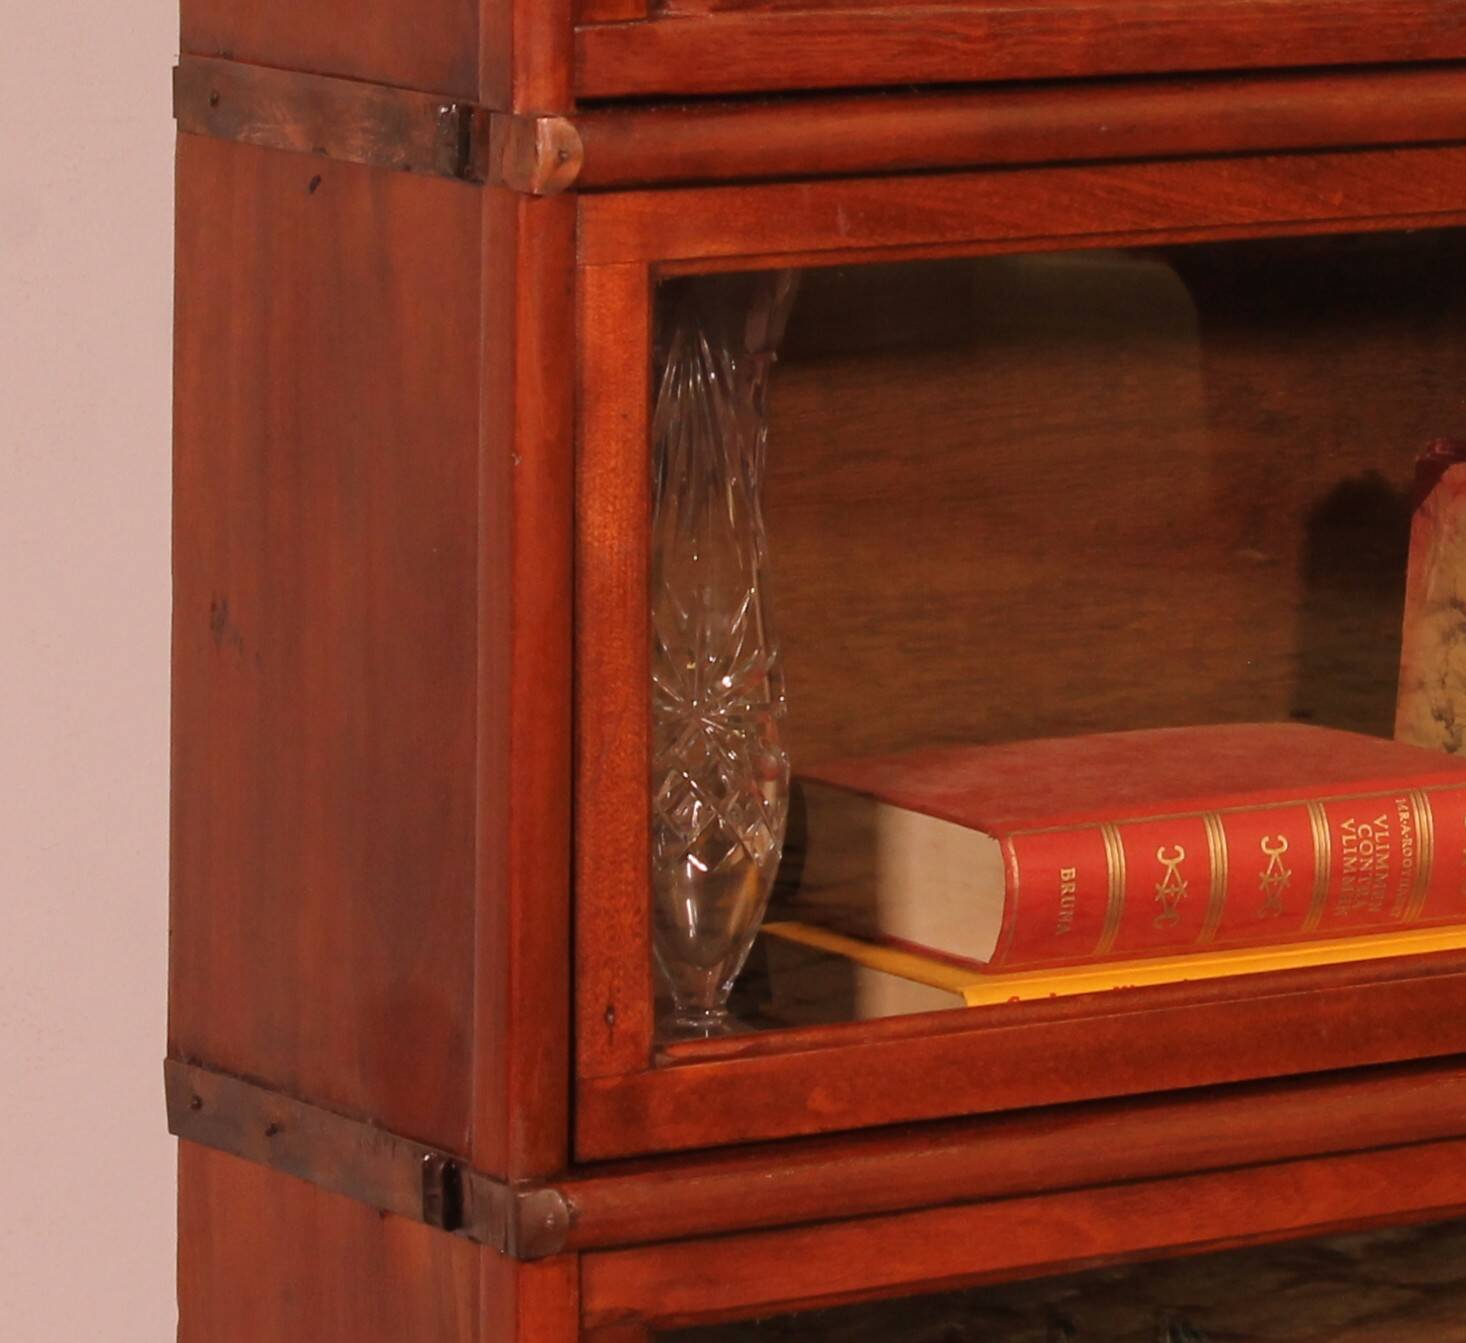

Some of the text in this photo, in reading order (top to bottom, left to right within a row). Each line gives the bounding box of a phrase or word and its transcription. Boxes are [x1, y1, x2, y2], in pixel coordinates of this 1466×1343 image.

[1055, 867, 1076, 936] BRUNA
[1334, 817, 1357, 917] VLIMMEN
[1351, 823, 1374, 910] CONTRA
[1368, 813, 1390, 913] VLIMMEN
